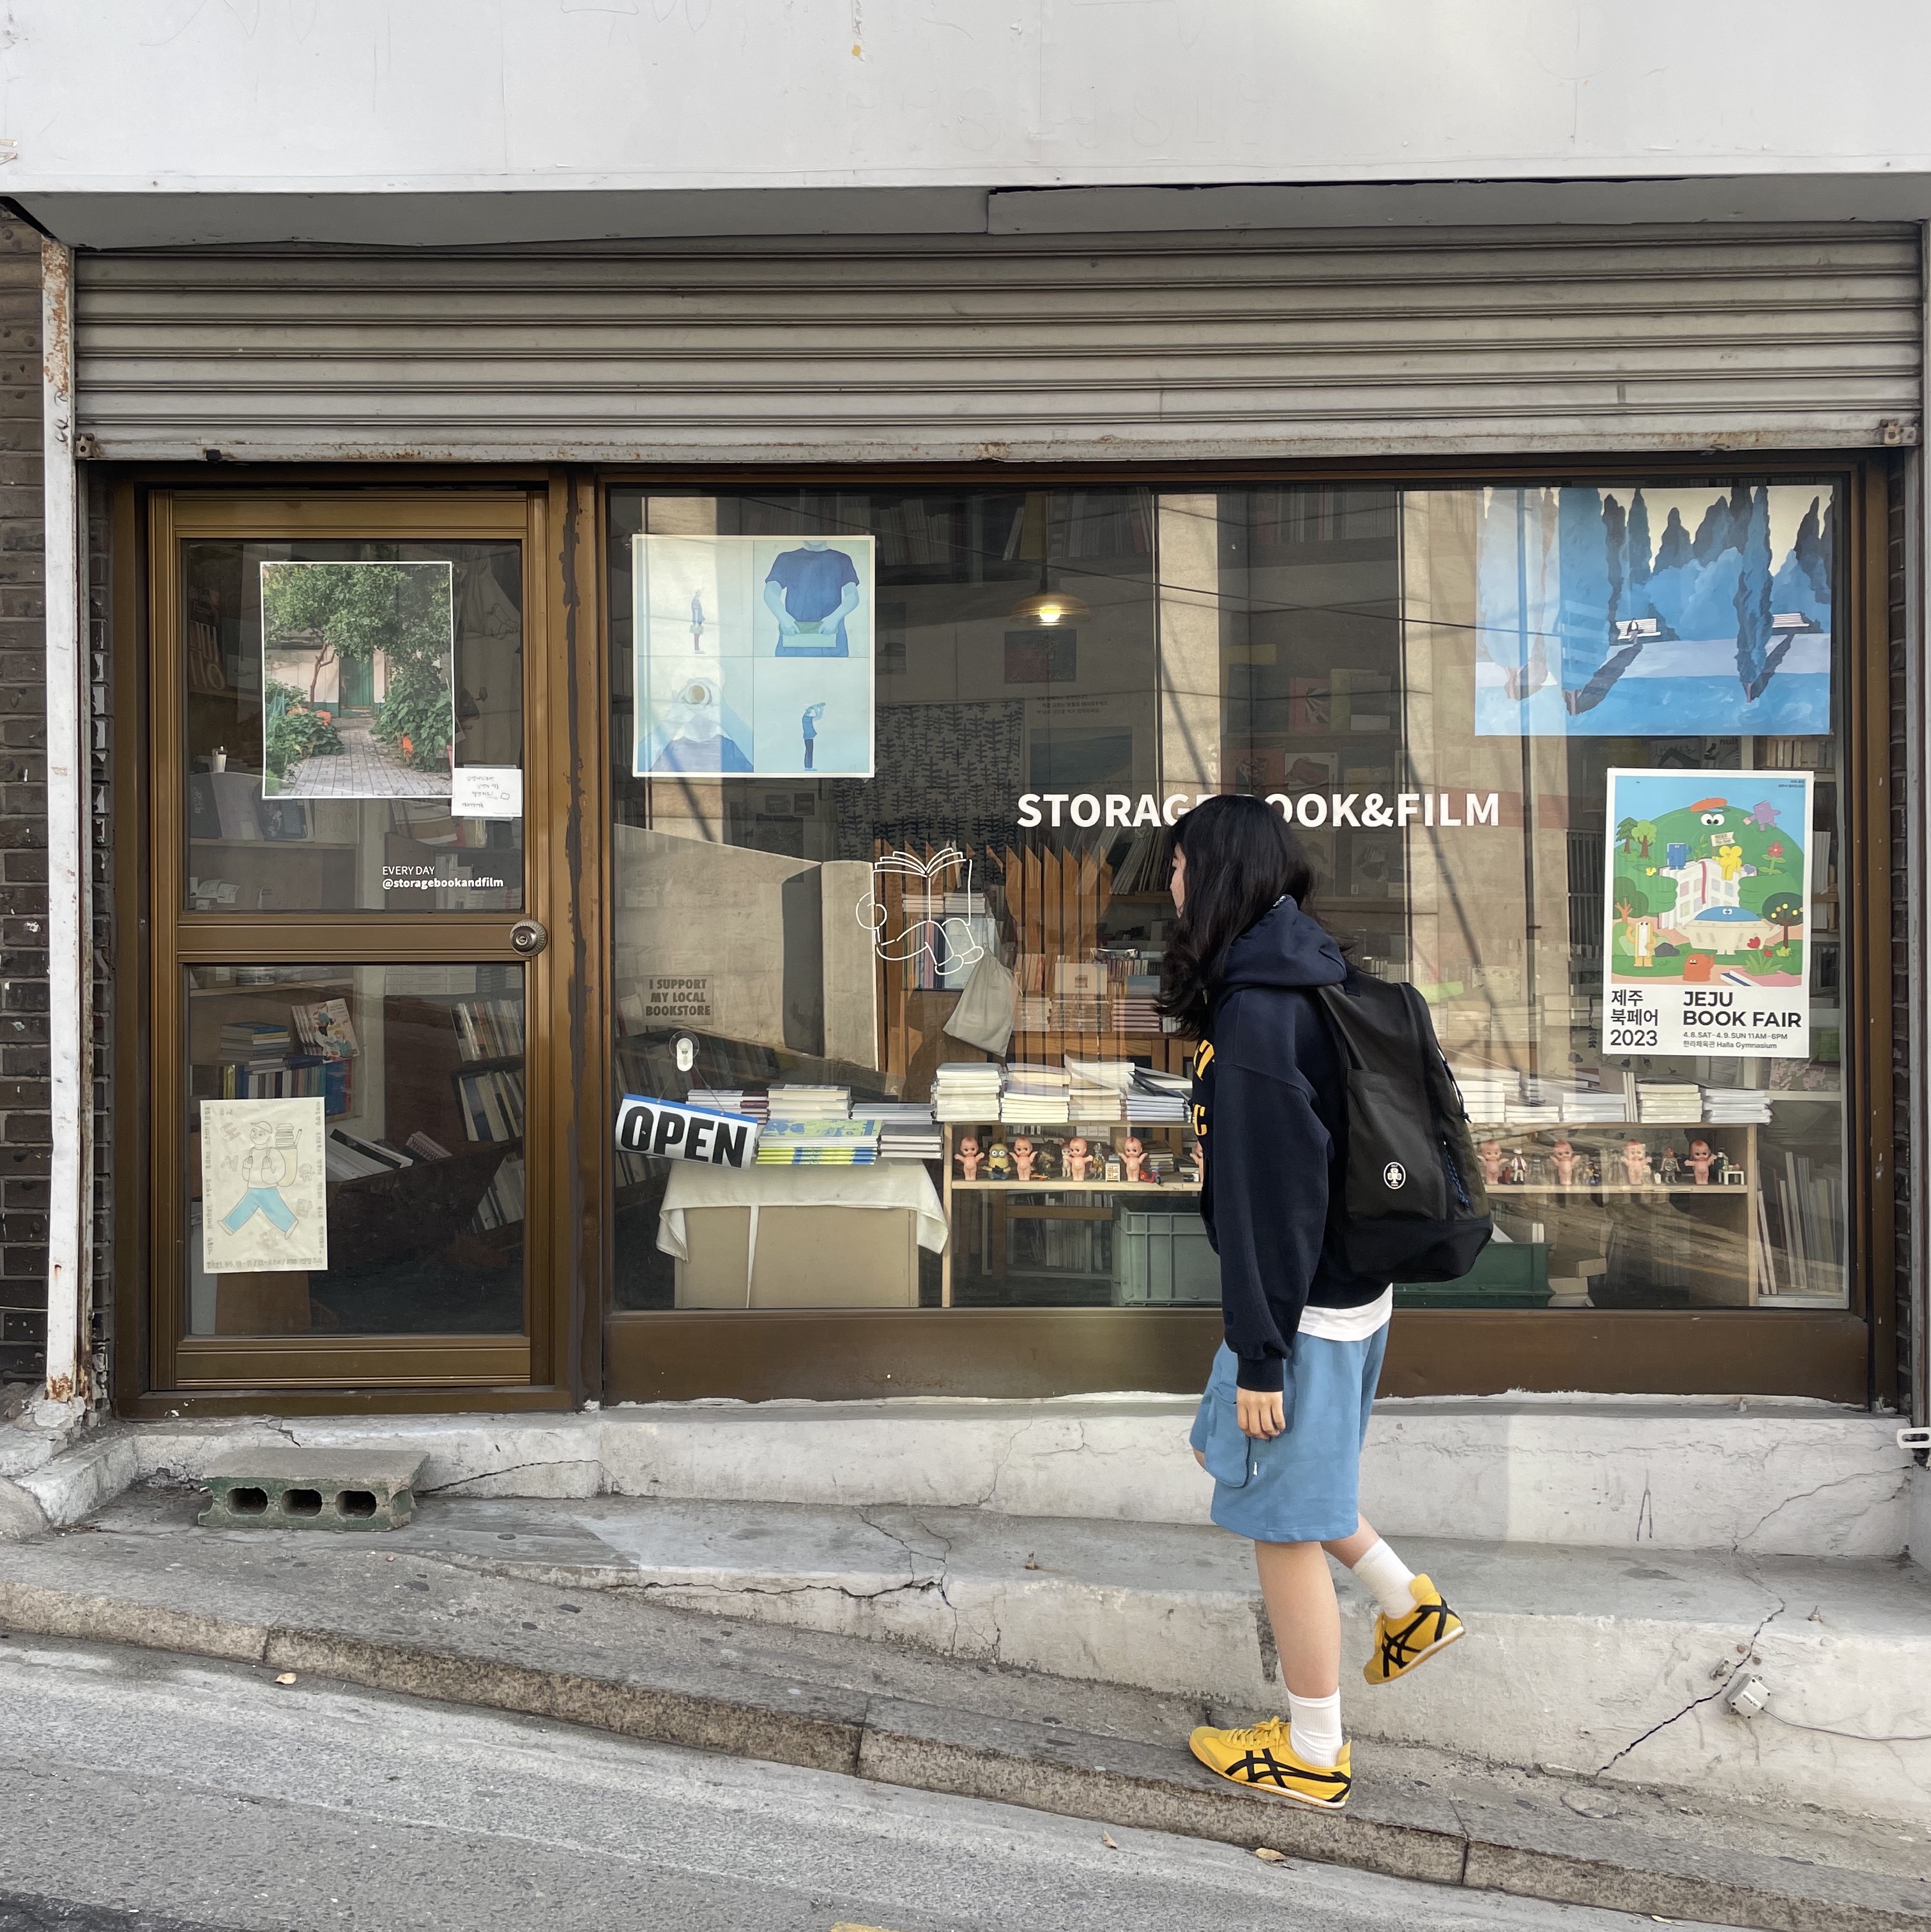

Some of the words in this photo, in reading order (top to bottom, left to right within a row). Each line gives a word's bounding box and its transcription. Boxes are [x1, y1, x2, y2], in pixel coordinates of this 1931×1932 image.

[1263, 793, 1499, 828] OOK&FILM
[382, 865, 415, 876] EVERY
[415, 865, 435, 876] DAY
[382, 877, 504, 890] @storagebookandfilm
[649, 979, 653, 989] I
[657, 978, 707, 989] SUPPORT
[650, 992, 669, 1003] MY
[673, 992, 706, 1003] LOCAL
[1611, 989, 1644, 1007] 제주
[1683, 991, 1734, 1007] JEJU
[645, 1005, 711, 1016] BOOKSTORE
[1610, 1008, 1658, 1026] 북페어
[1683, 1010, 1747, 1026] BOOK
[1752, 1011, 1802, 1028] FAIR
[1610, 1029, 1658, 1047] 2023
[1736, 1042, 1777, 1050] Gymnasium
[621, 1106, 748, 1168] OPEN
